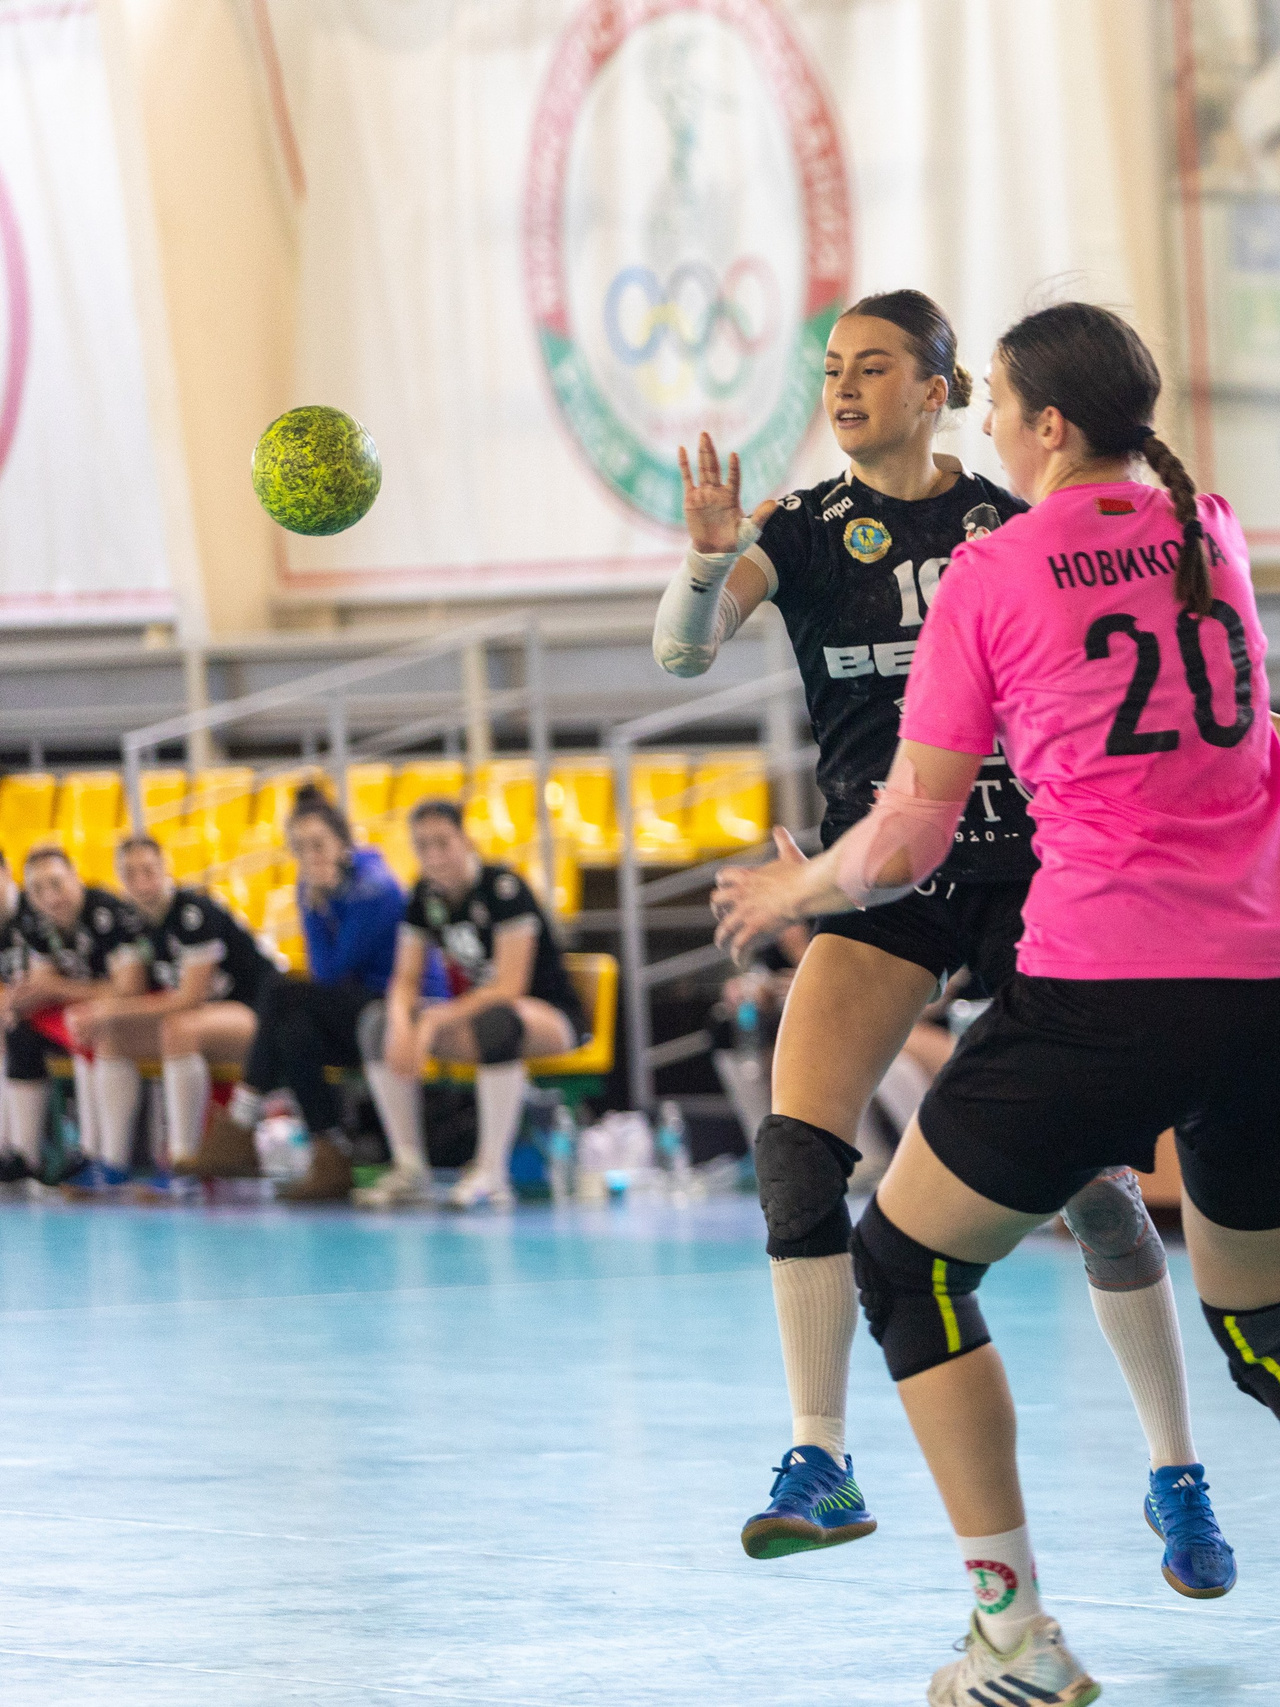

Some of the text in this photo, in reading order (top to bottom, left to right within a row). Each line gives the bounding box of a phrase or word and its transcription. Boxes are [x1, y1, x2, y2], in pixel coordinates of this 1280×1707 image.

[817, 496, 854, 522] mpa
[1047, 532, 1228, 589] НОВИКОА
[1084, 598, 1255, 756] 20
